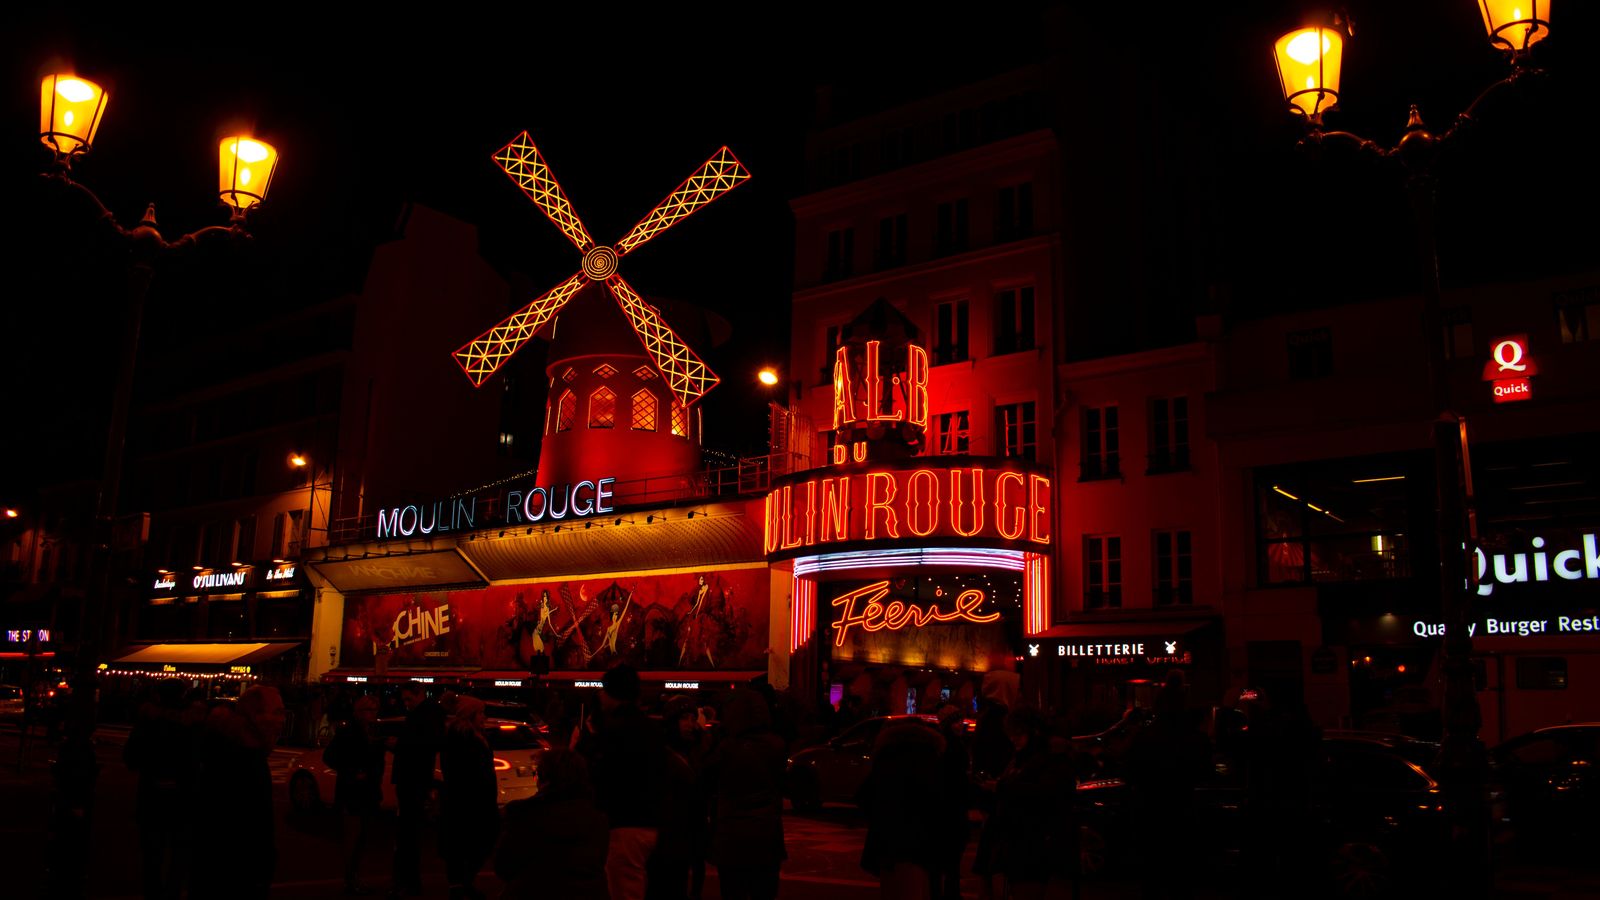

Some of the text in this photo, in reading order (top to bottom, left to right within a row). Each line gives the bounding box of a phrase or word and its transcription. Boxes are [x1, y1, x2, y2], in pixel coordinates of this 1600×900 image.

[1493, 340, 1526, 372] Q
[1493, 383, 1528, 396] Quick
[834, 442, 867, 464] DU
[376, 477, 615, 539] MOULIN ROUGE
[764, 469, 1049, 556] ULIN ROUGE
[832, 581, 1000, 647] Féerie
[8, 630, 20, 642] THE
[1413, 621, 1476, 638] Quay
[1486, 618, 1547, 636] Burger
[1057, 643, 1145, 656] BILLETTERIE
